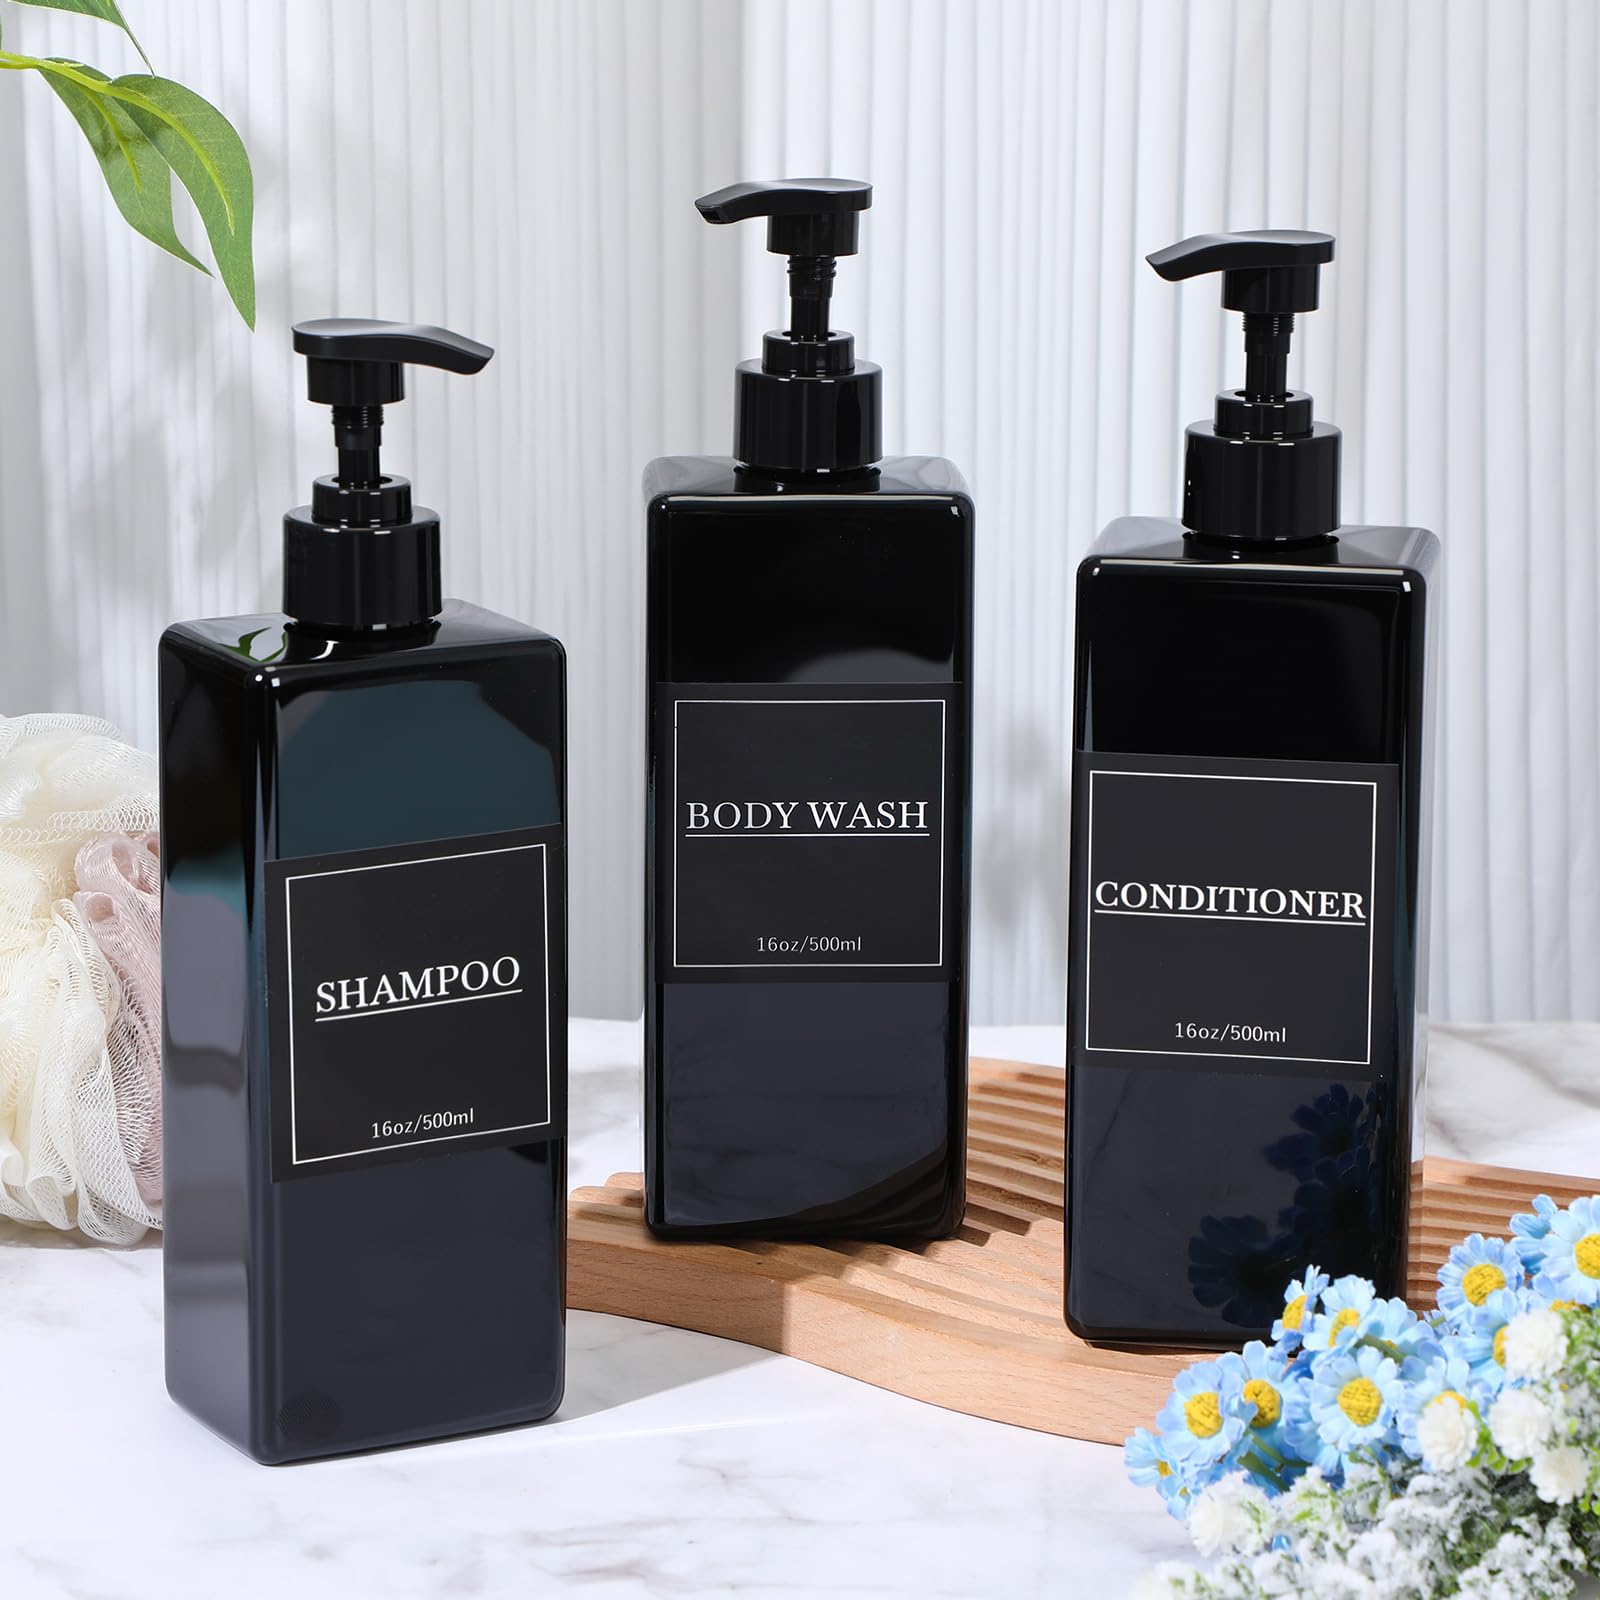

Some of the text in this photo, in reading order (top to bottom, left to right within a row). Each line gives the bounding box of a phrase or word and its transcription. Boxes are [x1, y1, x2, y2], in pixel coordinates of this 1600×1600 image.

[686, 801, 929, 829] BODY WASH
[1095, 880, 1367, 919] CONDITIONER
[757, 935, 862, 953] 16oz/500ml
[315, 956, 520, 1014] SHAMPOO
[1175, 1022, 1287, 1044] 16oz/500ml
[371, 1107, 475, 1139] 16oz/500ml
